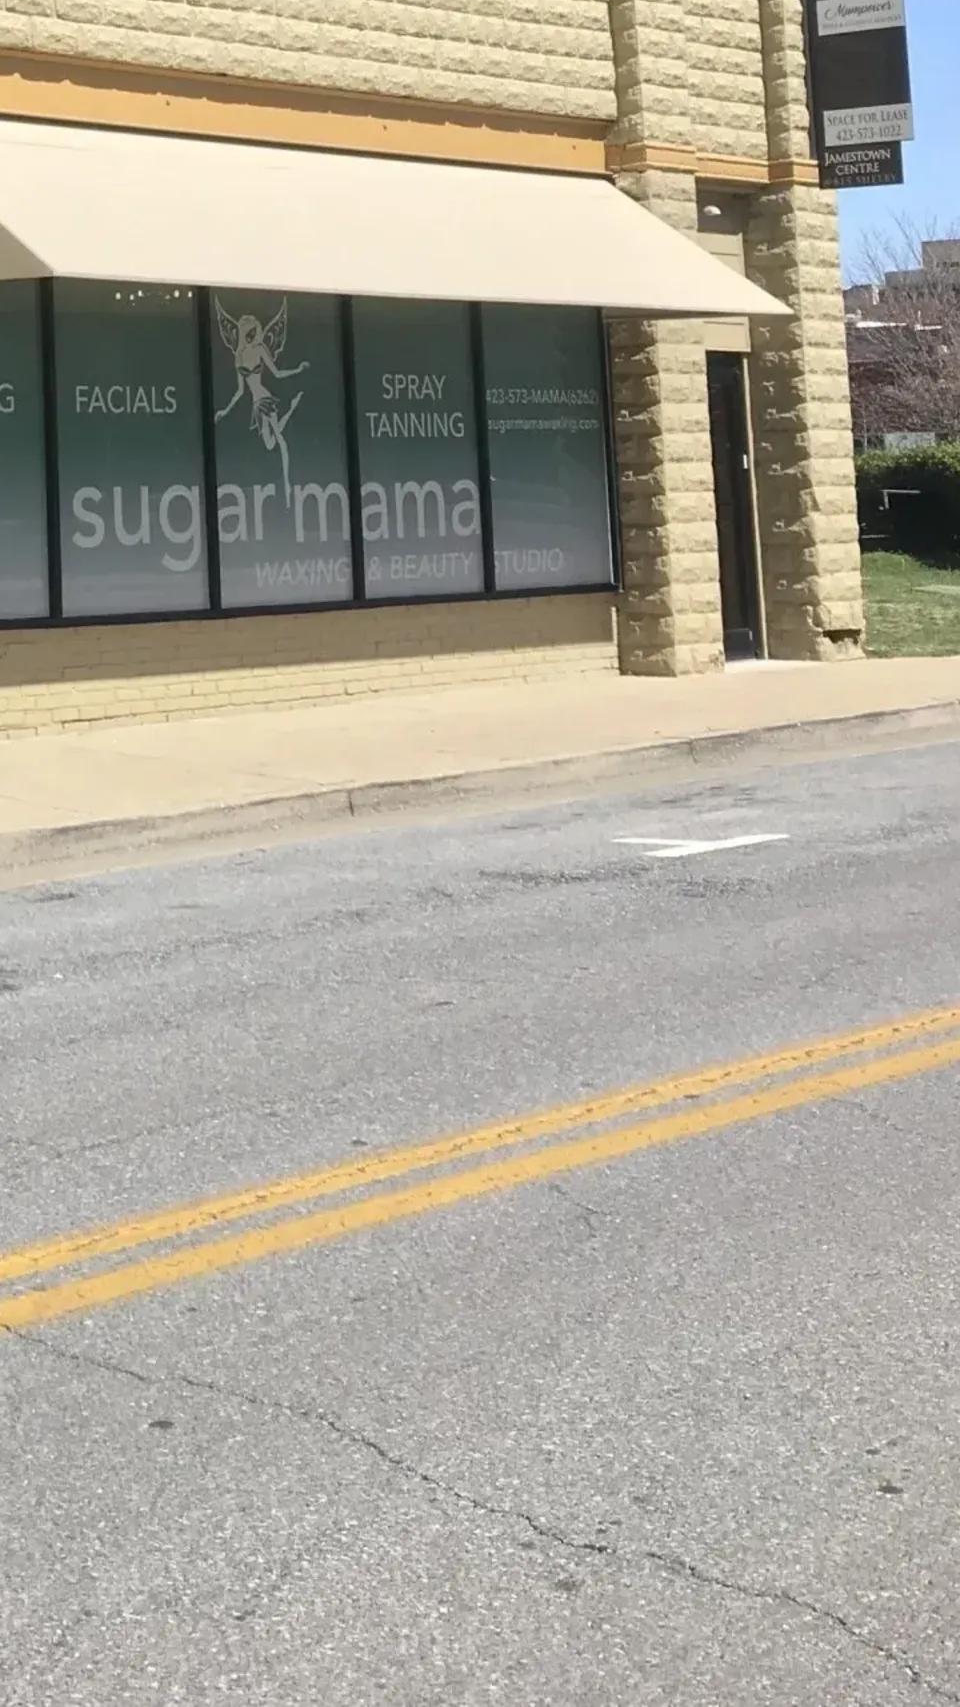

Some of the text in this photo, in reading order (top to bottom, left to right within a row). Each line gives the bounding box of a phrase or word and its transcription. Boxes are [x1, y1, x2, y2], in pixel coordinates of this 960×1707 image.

[827, 109, 908, 127] SPACE FOR LEASE
[836, 124, 902, 141] 423-573-1022
[825, 149, 891, 166] JAMESTOWN
[835, 162, 880, 175] CENTRE
[75, 385, 177, 413] FACIALS
[382, 374, 446, 400] SPRAY
[366, 412, 465, 438] TANNING
[71, 478, 480, 573] sugar mama
[255, 547, 564, 588] WAXING & BEAUTY STUDIO
